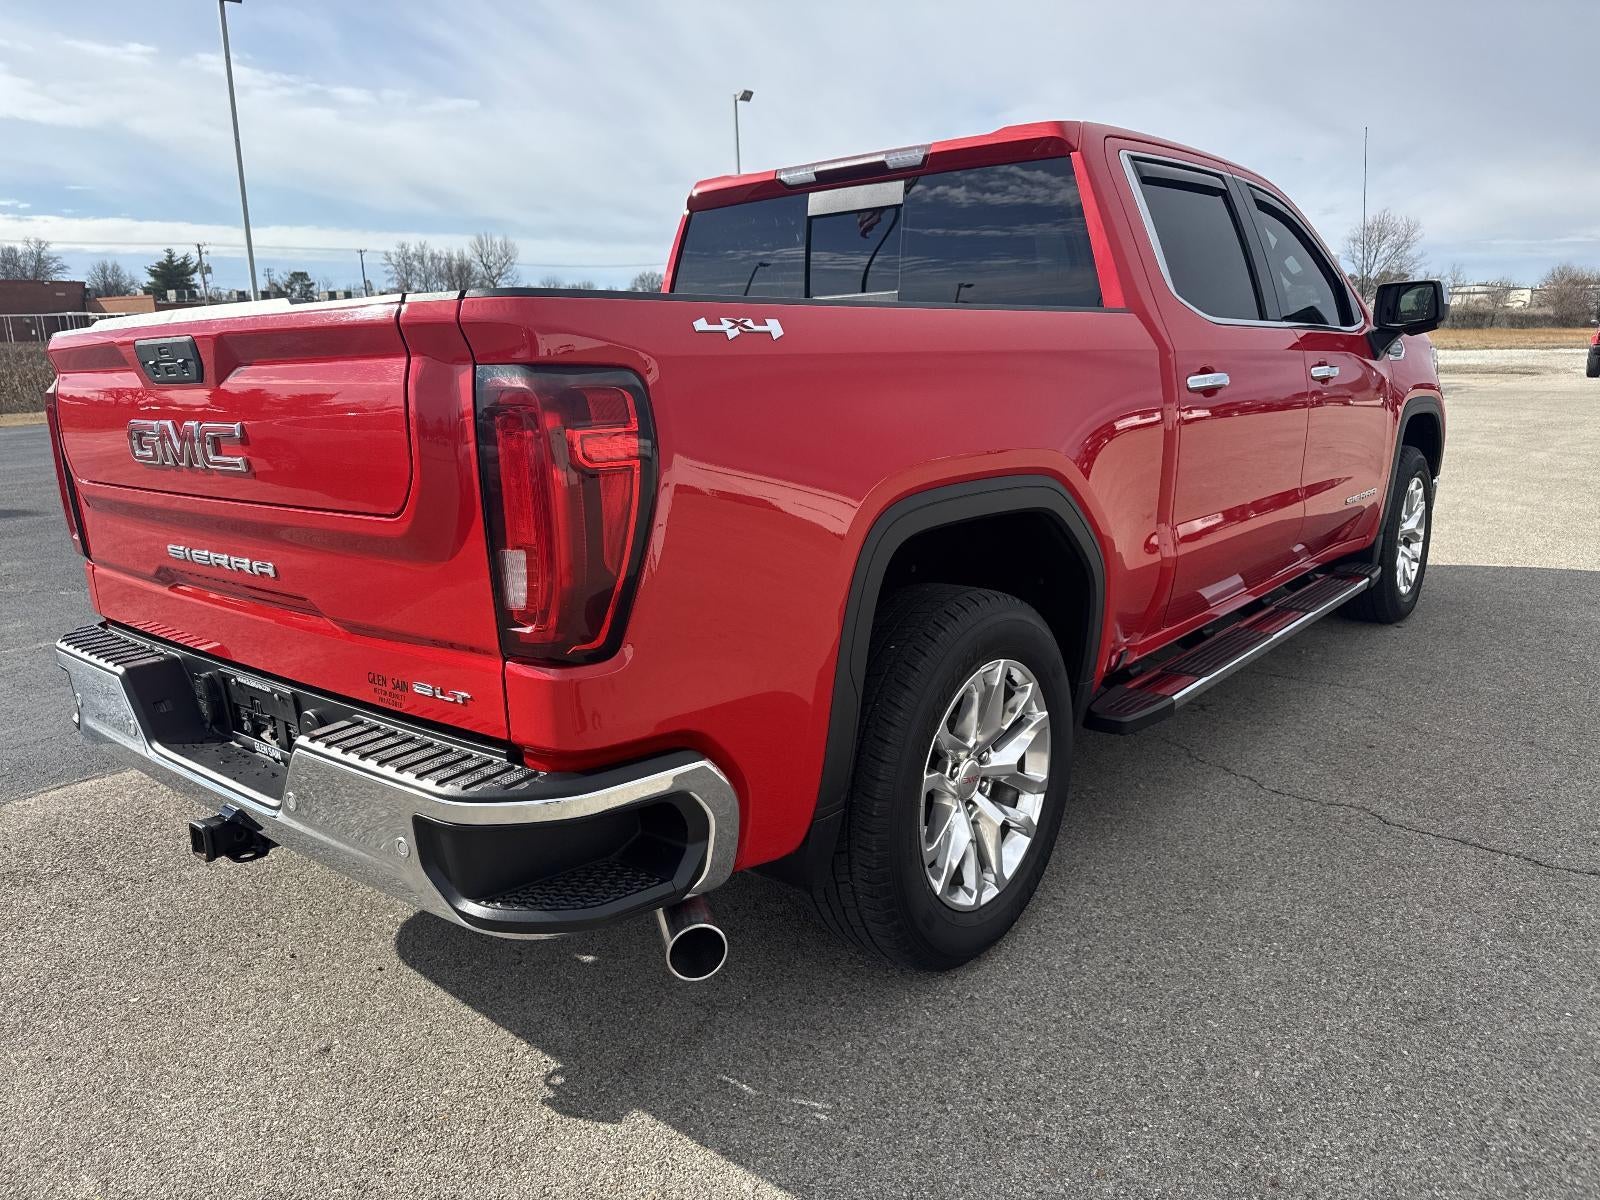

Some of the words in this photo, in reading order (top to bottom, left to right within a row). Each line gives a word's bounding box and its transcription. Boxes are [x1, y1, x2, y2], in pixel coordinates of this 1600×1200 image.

[126, 419, 249, 473] GMC
[1345, 487, 1377, 505] SIERRA
[166, 543, 278, 579] SIERRA
[367, 671, 388, 688] GLEN
[391, 678, 409, 694] SAIN
[412, 681, 473, 705] SLT
